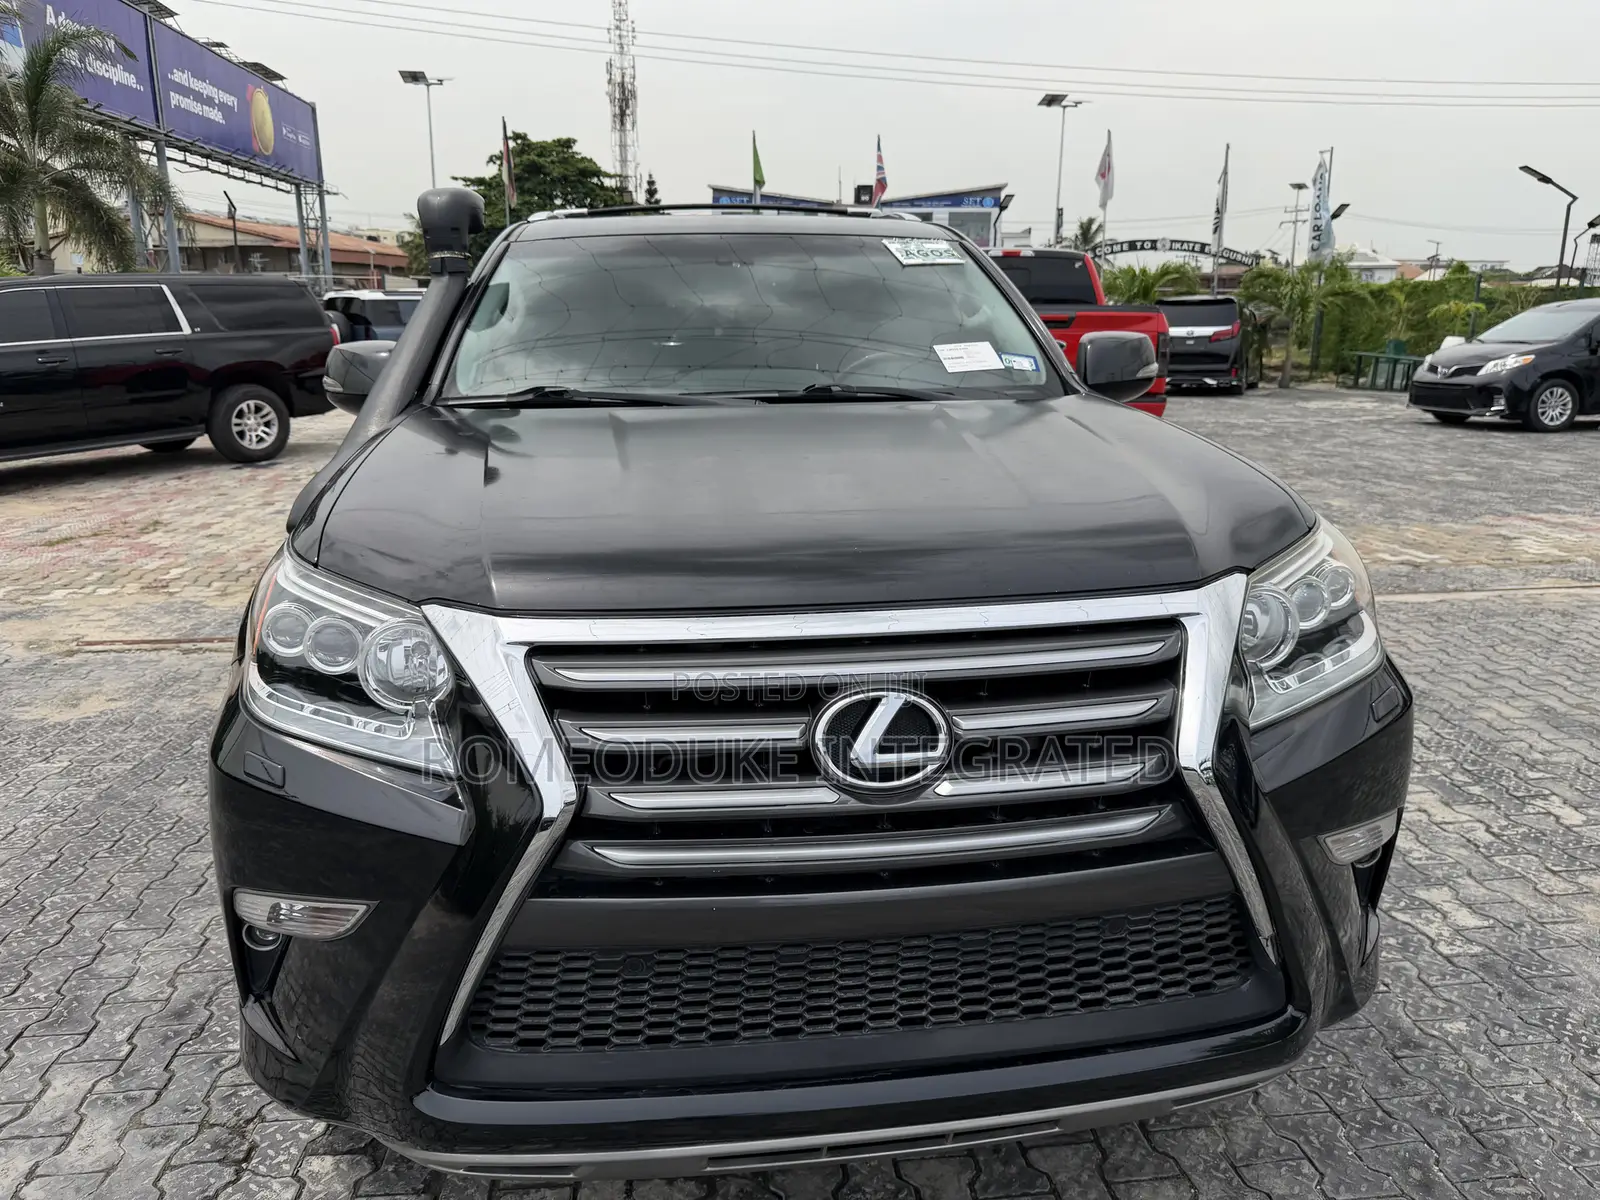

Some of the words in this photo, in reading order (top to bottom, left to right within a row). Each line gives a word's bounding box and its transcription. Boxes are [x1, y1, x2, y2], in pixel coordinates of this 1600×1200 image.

[188, 71, 219, 104] keeping
[218, 89, 238, 113] every
[169, 91, 203, 116] promise
[202, 104, 226, 125] made.
[962, 197, 983, 206] SET
[1135, 241, 1152, 250] TO
[1171, 241, 1201, 251] IKATE
[1311, 223, 1324, 252] CAR
